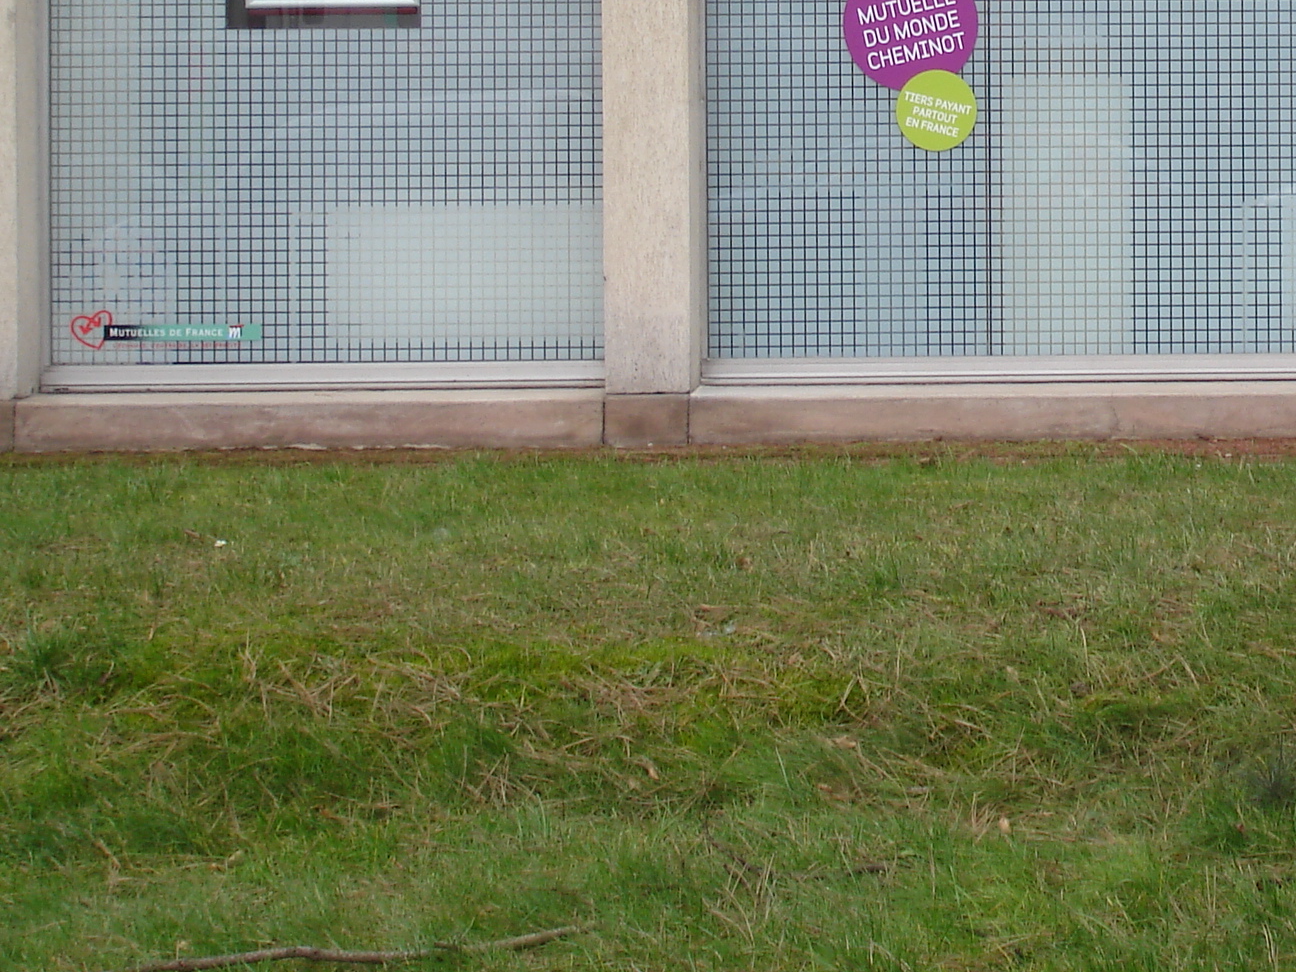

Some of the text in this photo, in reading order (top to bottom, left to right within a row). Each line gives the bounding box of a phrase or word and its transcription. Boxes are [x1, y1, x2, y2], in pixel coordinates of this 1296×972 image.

[862, 9, 961, 49] DU MONDE
[866, 31, 965, 71] CHEMINOT
[904, 90, 972, 116] TIERS PAYANT
[912, 105, 958, 125] PARTOUT
[905, 116, 960, 138] EN FRANCE
[109, 327, 166, 337] MUTUELLES
[168, 327, 182, 337] DE
[185, 327, 224, 337] FRANCE
